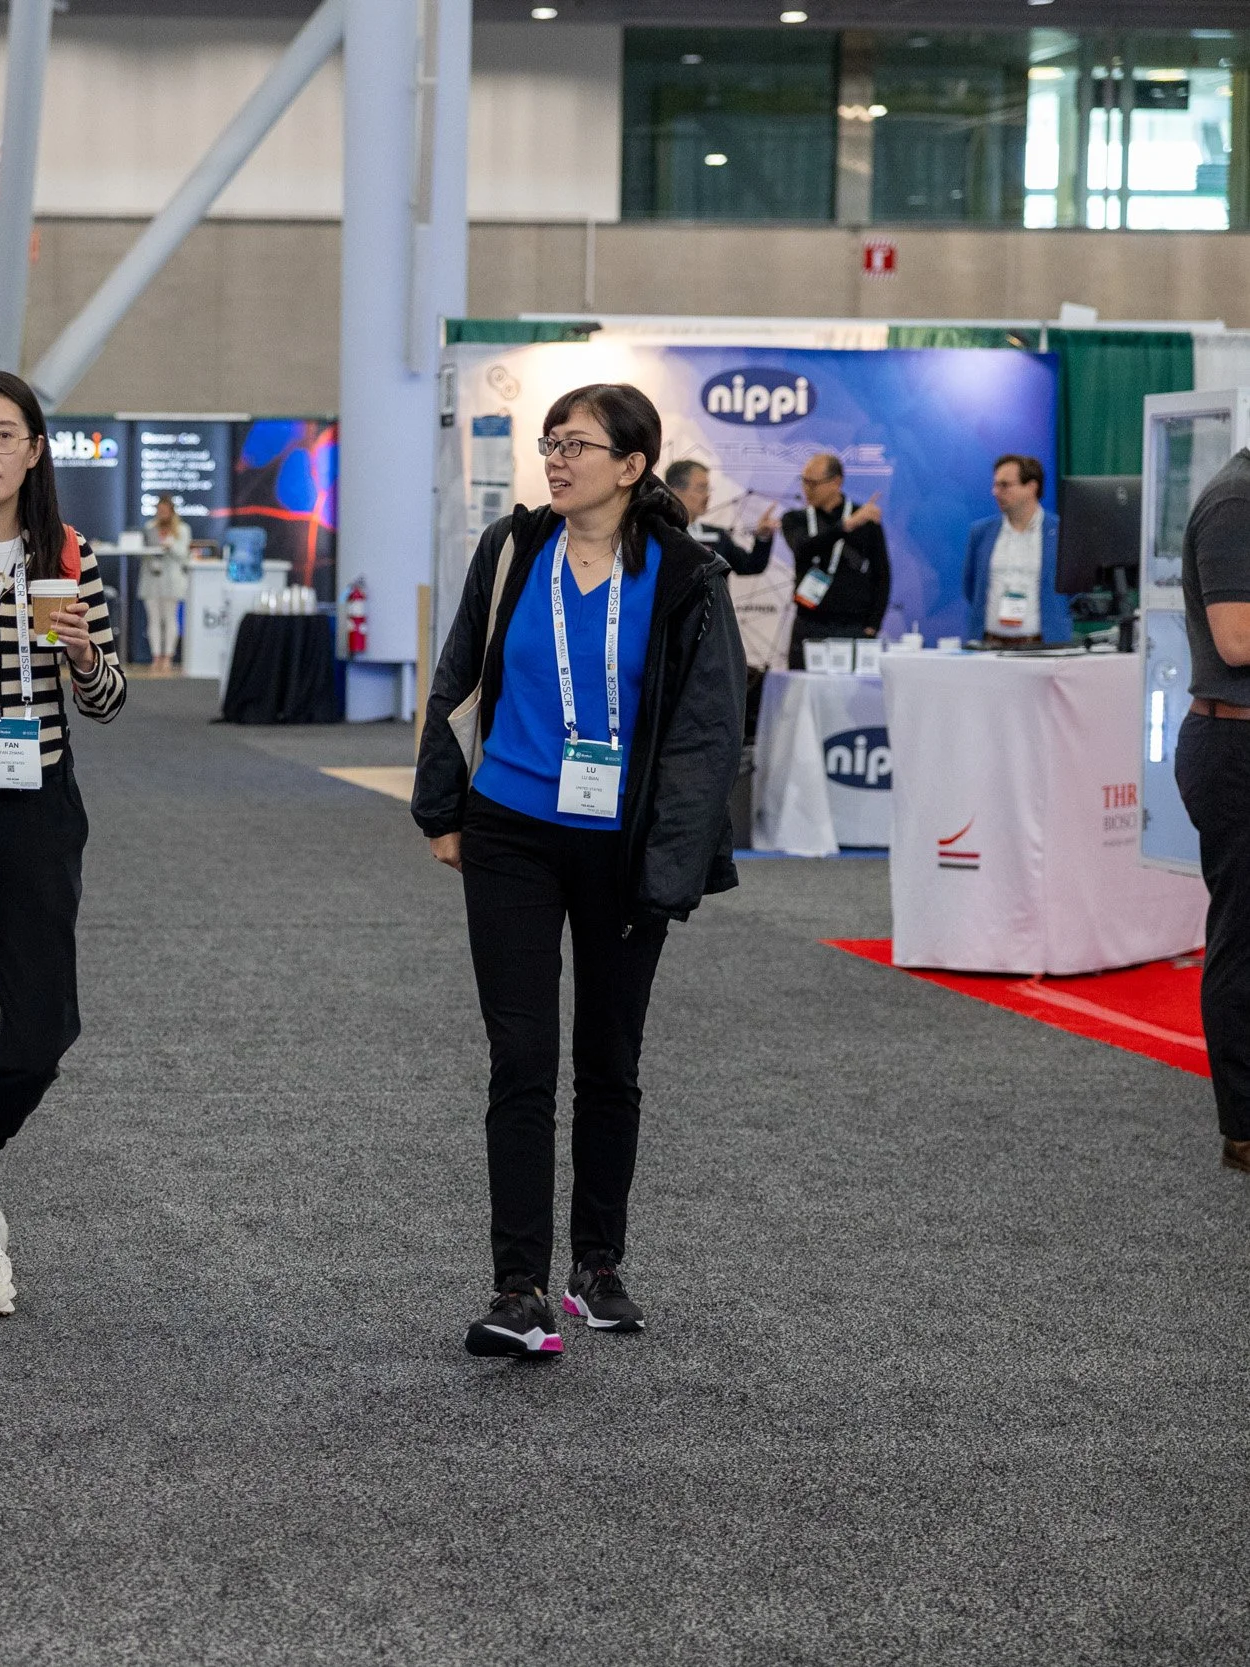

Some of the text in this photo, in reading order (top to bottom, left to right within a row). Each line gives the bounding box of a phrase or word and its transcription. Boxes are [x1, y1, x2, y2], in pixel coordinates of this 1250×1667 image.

[707, 374, 809, 423] nippi
[16, 570, 25, 597] ISSCR
[553, 587, 563, 616] ISSCR
[609, 586, 619, 615] ISSCR
[21, 655, 30, 683] ISSCR
[561, 677, 573, 707] ISSCR
[608, 676, 617, 706] ISSCR
